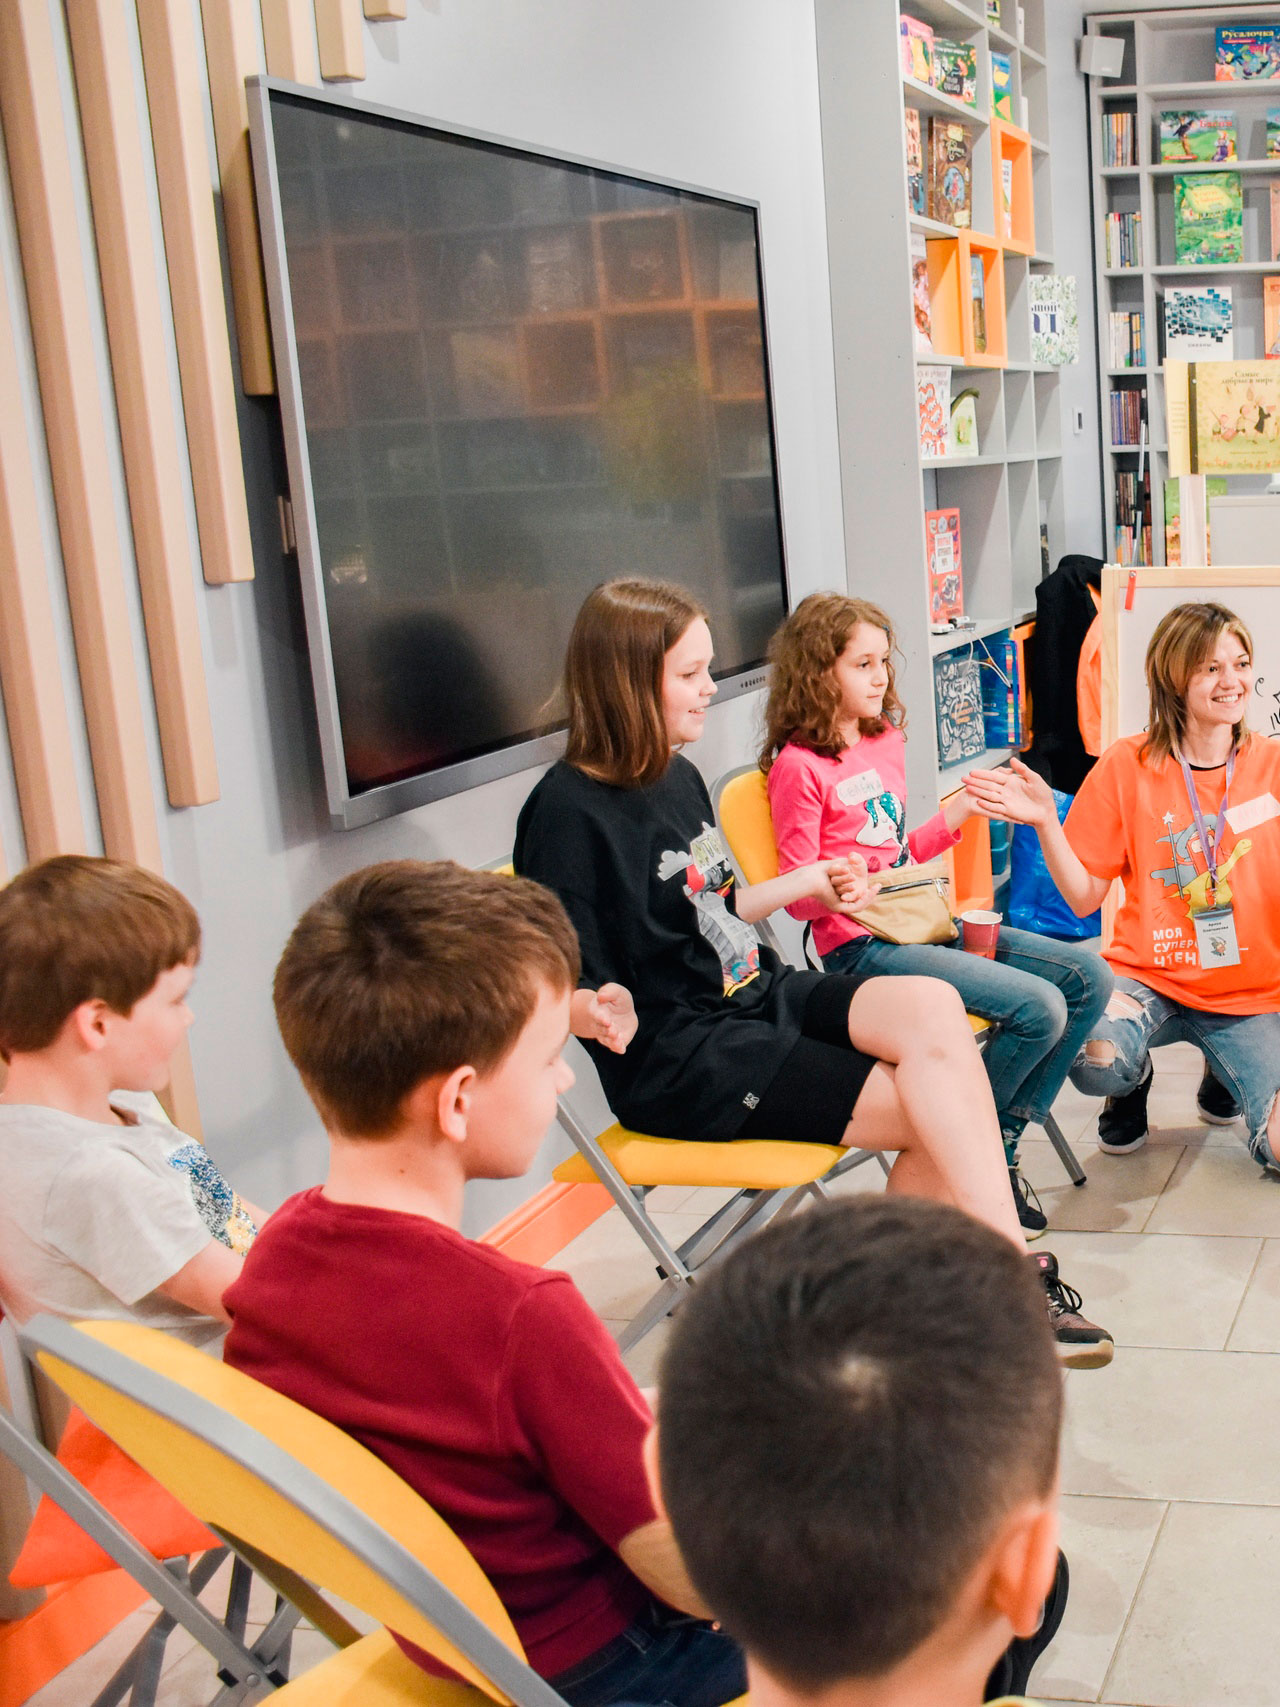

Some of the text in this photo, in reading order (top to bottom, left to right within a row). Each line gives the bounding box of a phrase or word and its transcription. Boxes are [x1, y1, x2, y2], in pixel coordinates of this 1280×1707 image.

[1221, 30, 1275, 42] Русалочка
[1234, 370, 1260, 379] Самые
[1153, 929, 1183, 941] МОЯ
[1153, 951, 1202, 967] ЧТЕН
